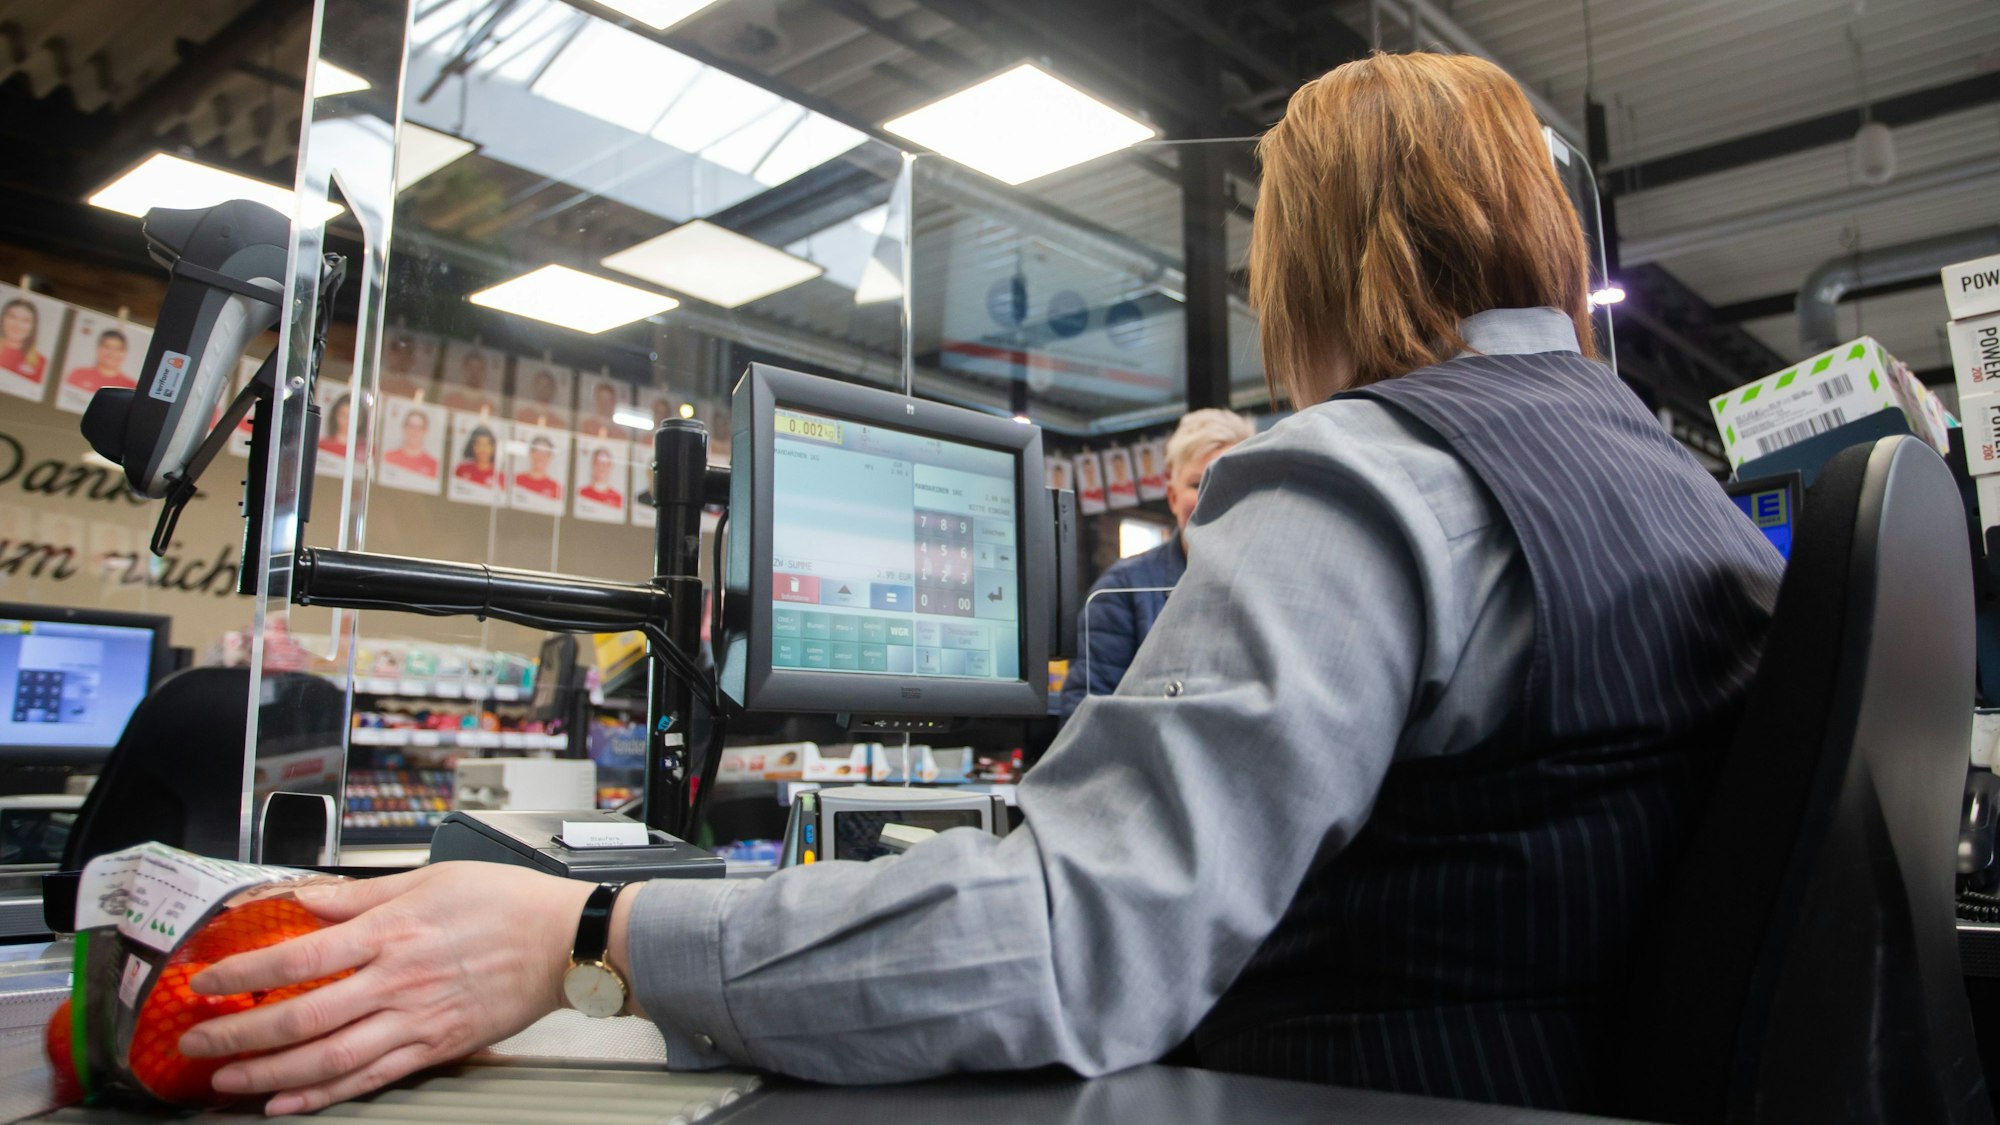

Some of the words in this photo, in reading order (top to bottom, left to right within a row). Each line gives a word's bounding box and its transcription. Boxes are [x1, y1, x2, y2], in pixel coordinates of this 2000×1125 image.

[1971, 367, 1984, 383] 200
[789, 418, 823, 438] 0.002
[1982, 444, 1994, 461] 200
[920, 515, 927, 528] 7
[940, 518, 947, 531] 8
[960, 521, 967, 534] 9
[920, 542, 927, 553] 4
[940, 544, 947, 557] 5
[960, 547, 967, 559] 6
[921, 568, 927, 580] 1
[941, 570, 947, 582] 2
[961, 572, 967, 584] 3
[920, 593, 928, 607] 0
[958, 597, 971, 610] 00
